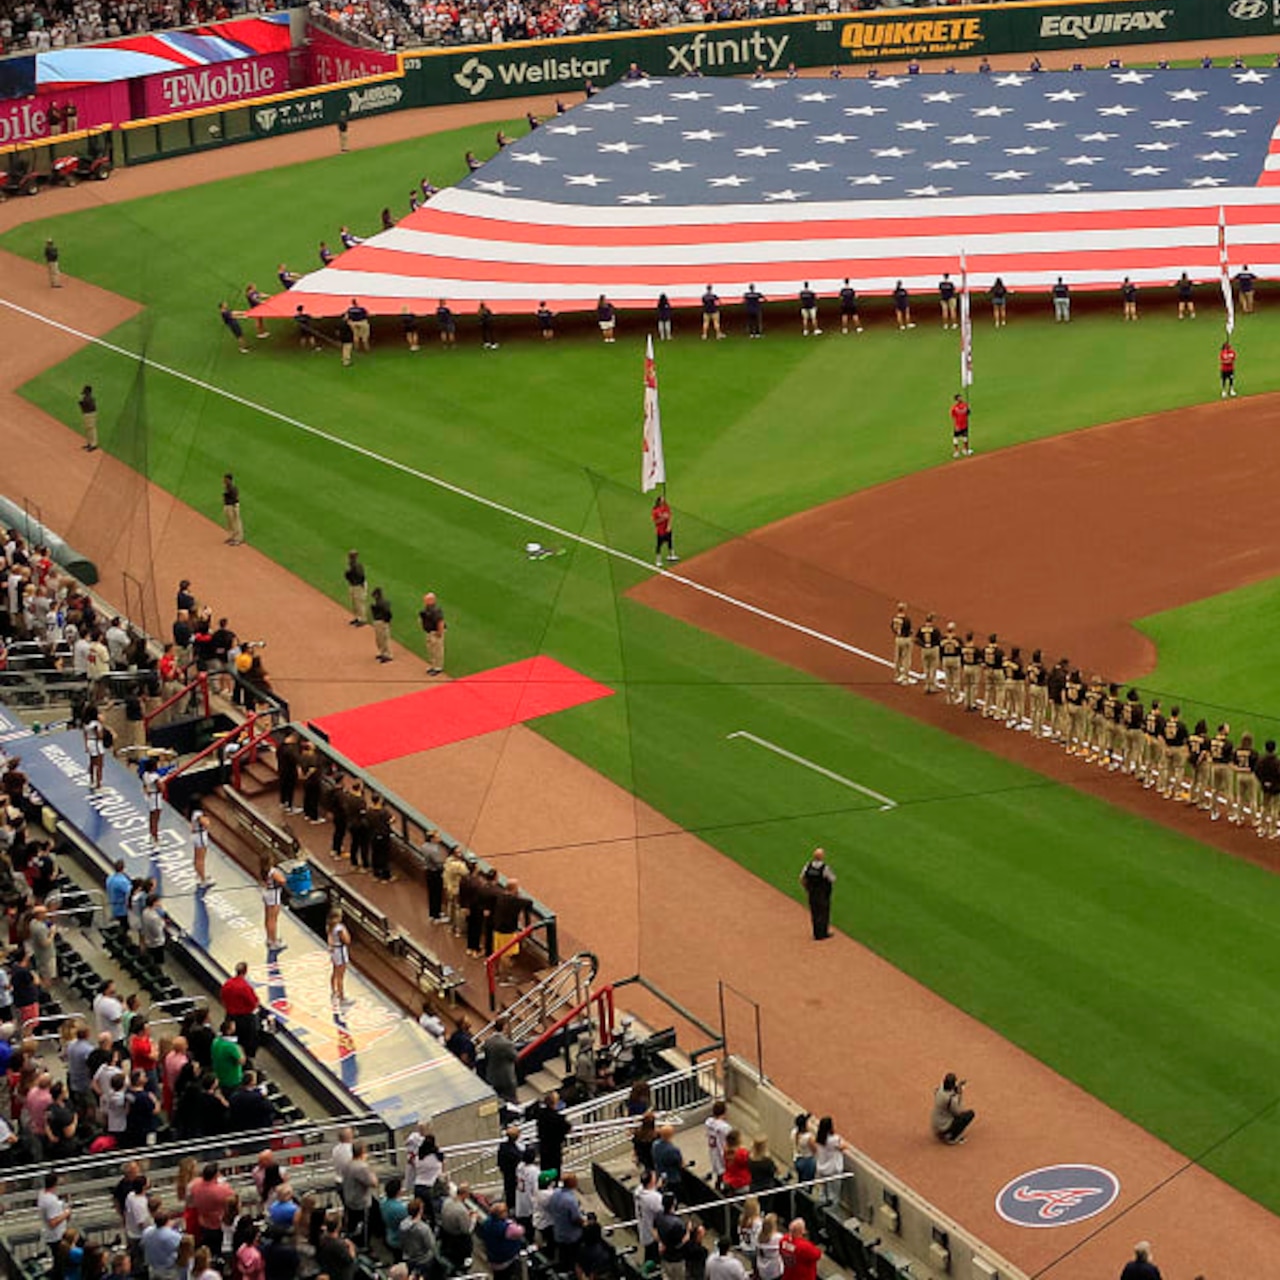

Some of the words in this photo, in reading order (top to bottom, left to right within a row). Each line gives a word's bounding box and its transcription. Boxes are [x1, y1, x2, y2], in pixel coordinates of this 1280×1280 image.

[840, 18, 981, 49] QUIKRETE
[1038, 11, 1168, 40] EQUIFAX
[668, 31, 790, 72] xfinity
[499, 56, 610, 84] Wellstar
[278, 99, 324, 118] TYM
